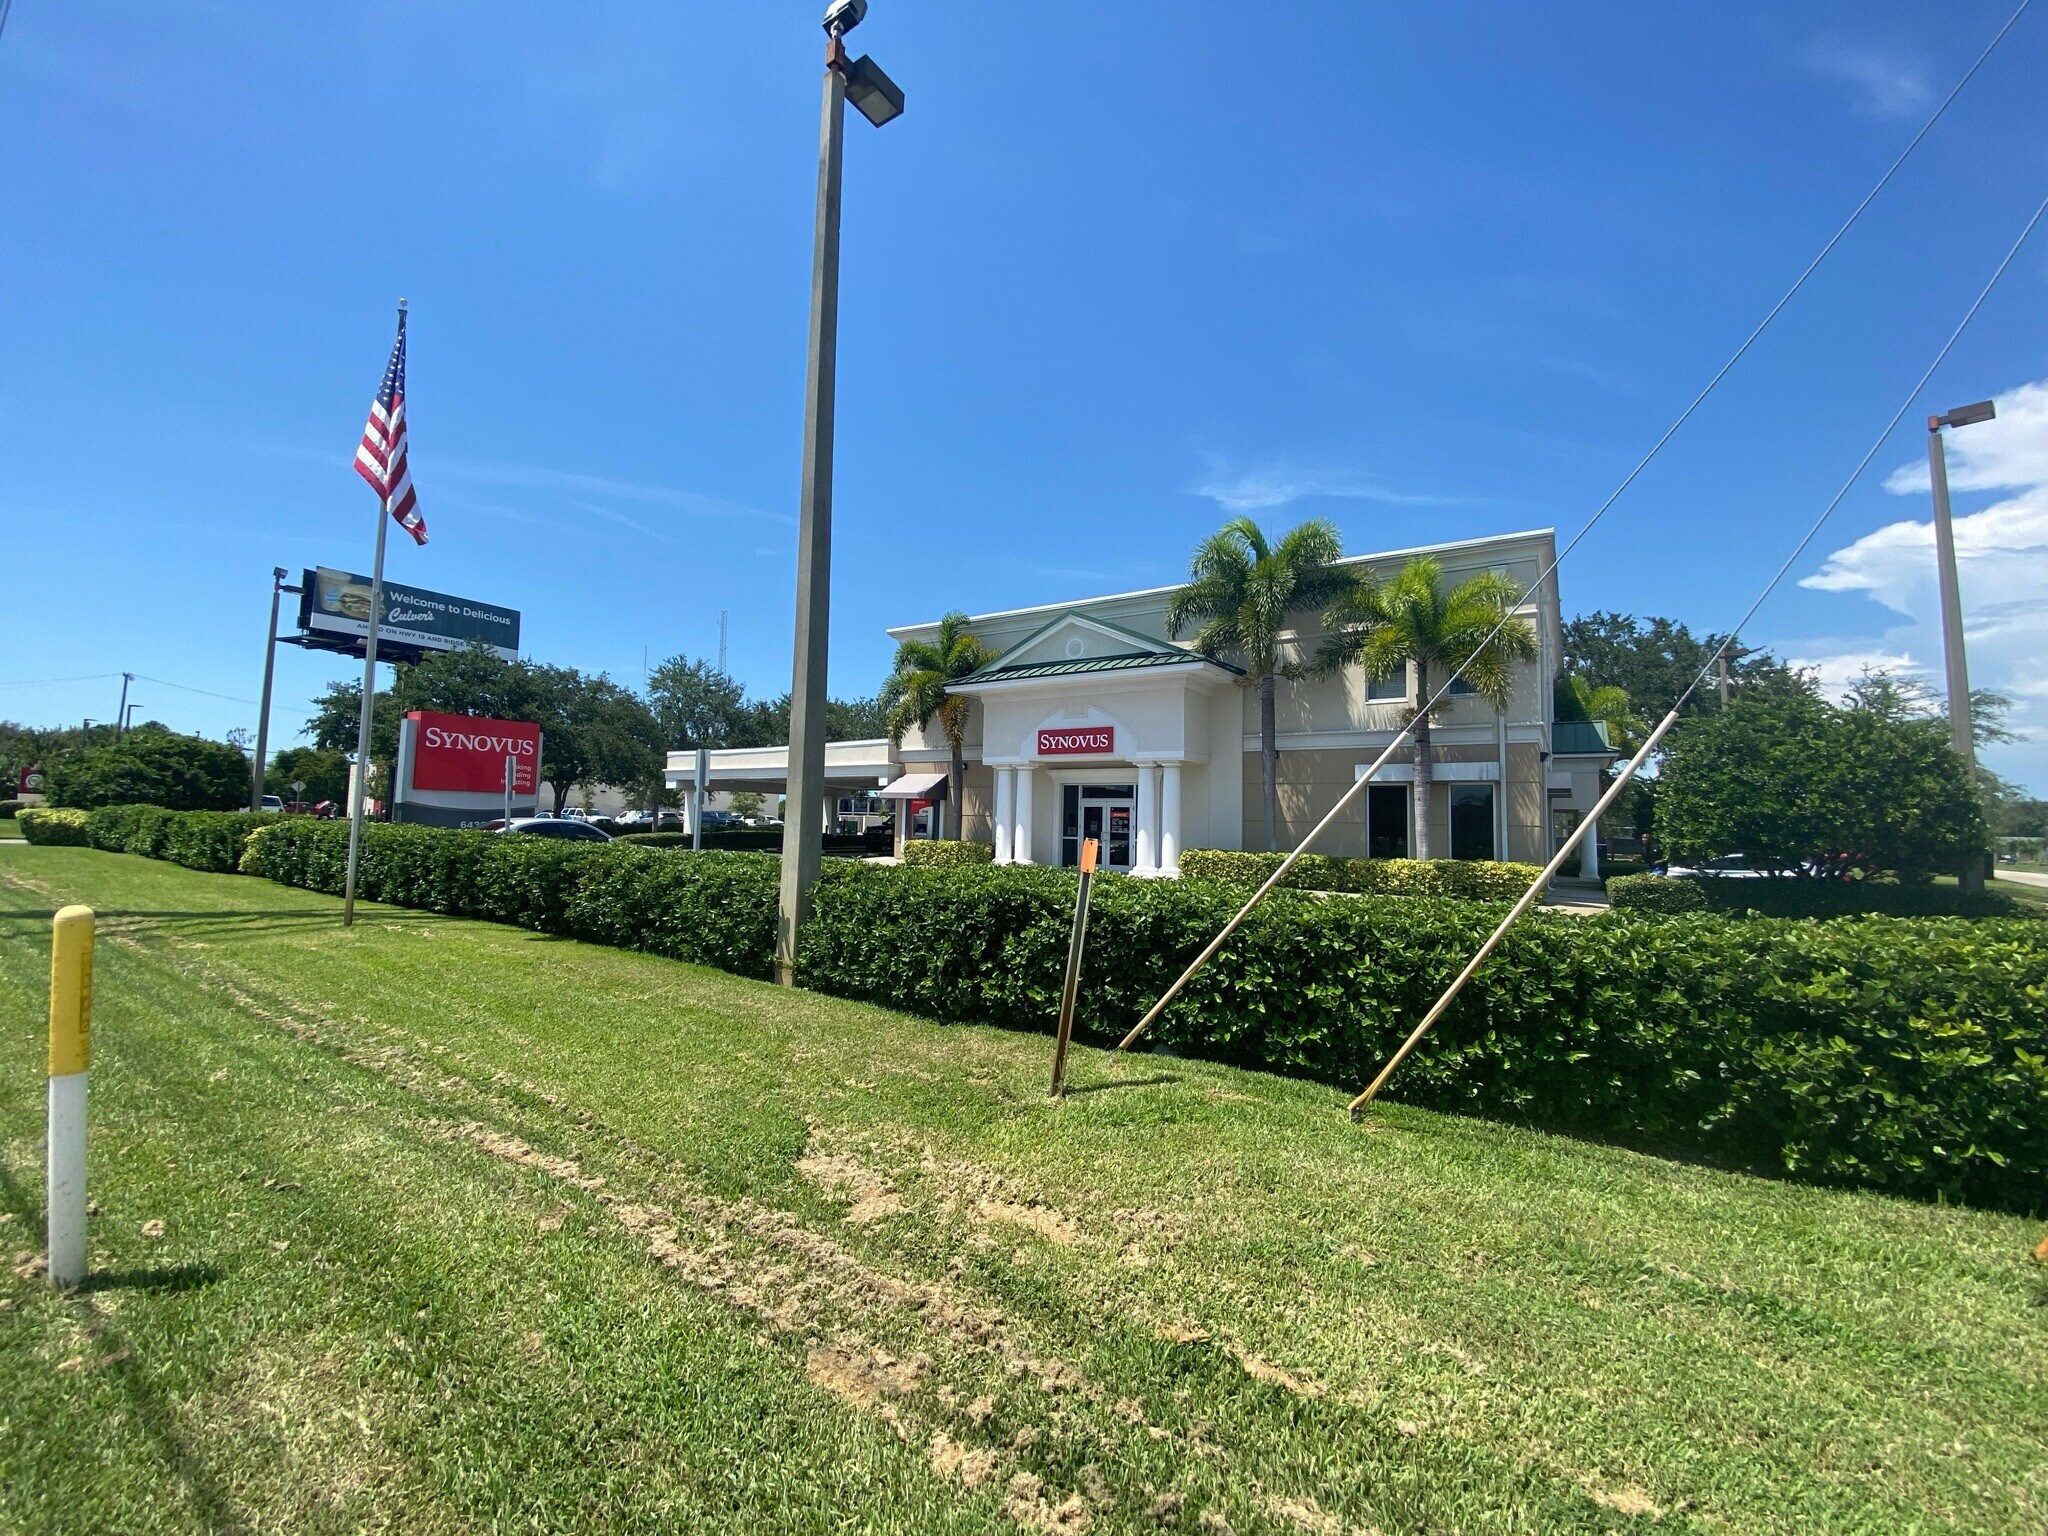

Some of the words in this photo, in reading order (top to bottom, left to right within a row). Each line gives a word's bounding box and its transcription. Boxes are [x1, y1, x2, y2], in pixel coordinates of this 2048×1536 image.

[388, 607, 434, 623] Culver's
[390, 591, 446, 611] Welcome
[448, 604, 460, 614] to
[463, 607, 511, 625] Delicious
[357, 623, 384, 632] AHD
[399, 630, 416, 638] HWY
[443, 639, 464, 647] RIDGE
[425, 727, 534, 756] SYNOVUS
[1040, 733, 1109, 749] SYNOVUS
